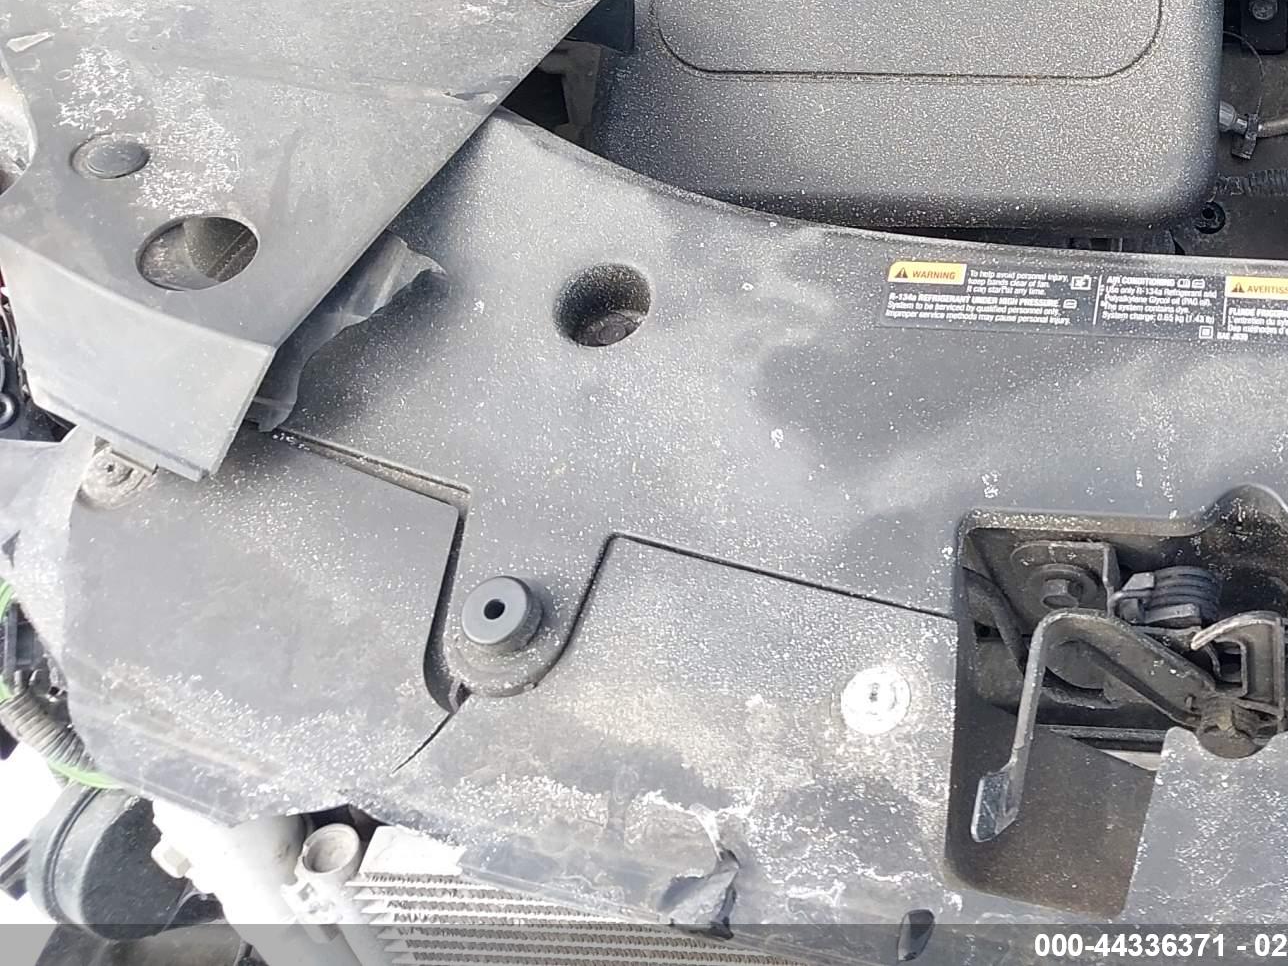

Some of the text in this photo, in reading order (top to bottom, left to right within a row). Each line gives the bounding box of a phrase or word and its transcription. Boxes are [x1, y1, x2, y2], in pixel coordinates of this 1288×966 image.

[912, 271, 955, 279] WARNING
[1107, 276, 1175, 287] AIR CONDITIONING
[1120, 287, 1134, 295] only
[889, 293, 917, 301] R-134a
[918, 294, 971, 303] REFRIGERANT
[971, 296, 997, 304] UNDER
[999, 297, 1018, 305] HIGH
[887, 301, 914, 309] System
[966, 304, 975, 312] by
[976, 306, 1006, 315] qualified
[1118, 304, 1143, 312] system
[1144, 305, 1174, 313] contains
[1175, 306, 1190, 314] dye.
[885, 310, 918, 318] Improper
[919, 311, 945, 319] service
[946, 312, 977, 320] methods
[978, 314, 994, 322] may
[1102, 311, 1128, 320] System
